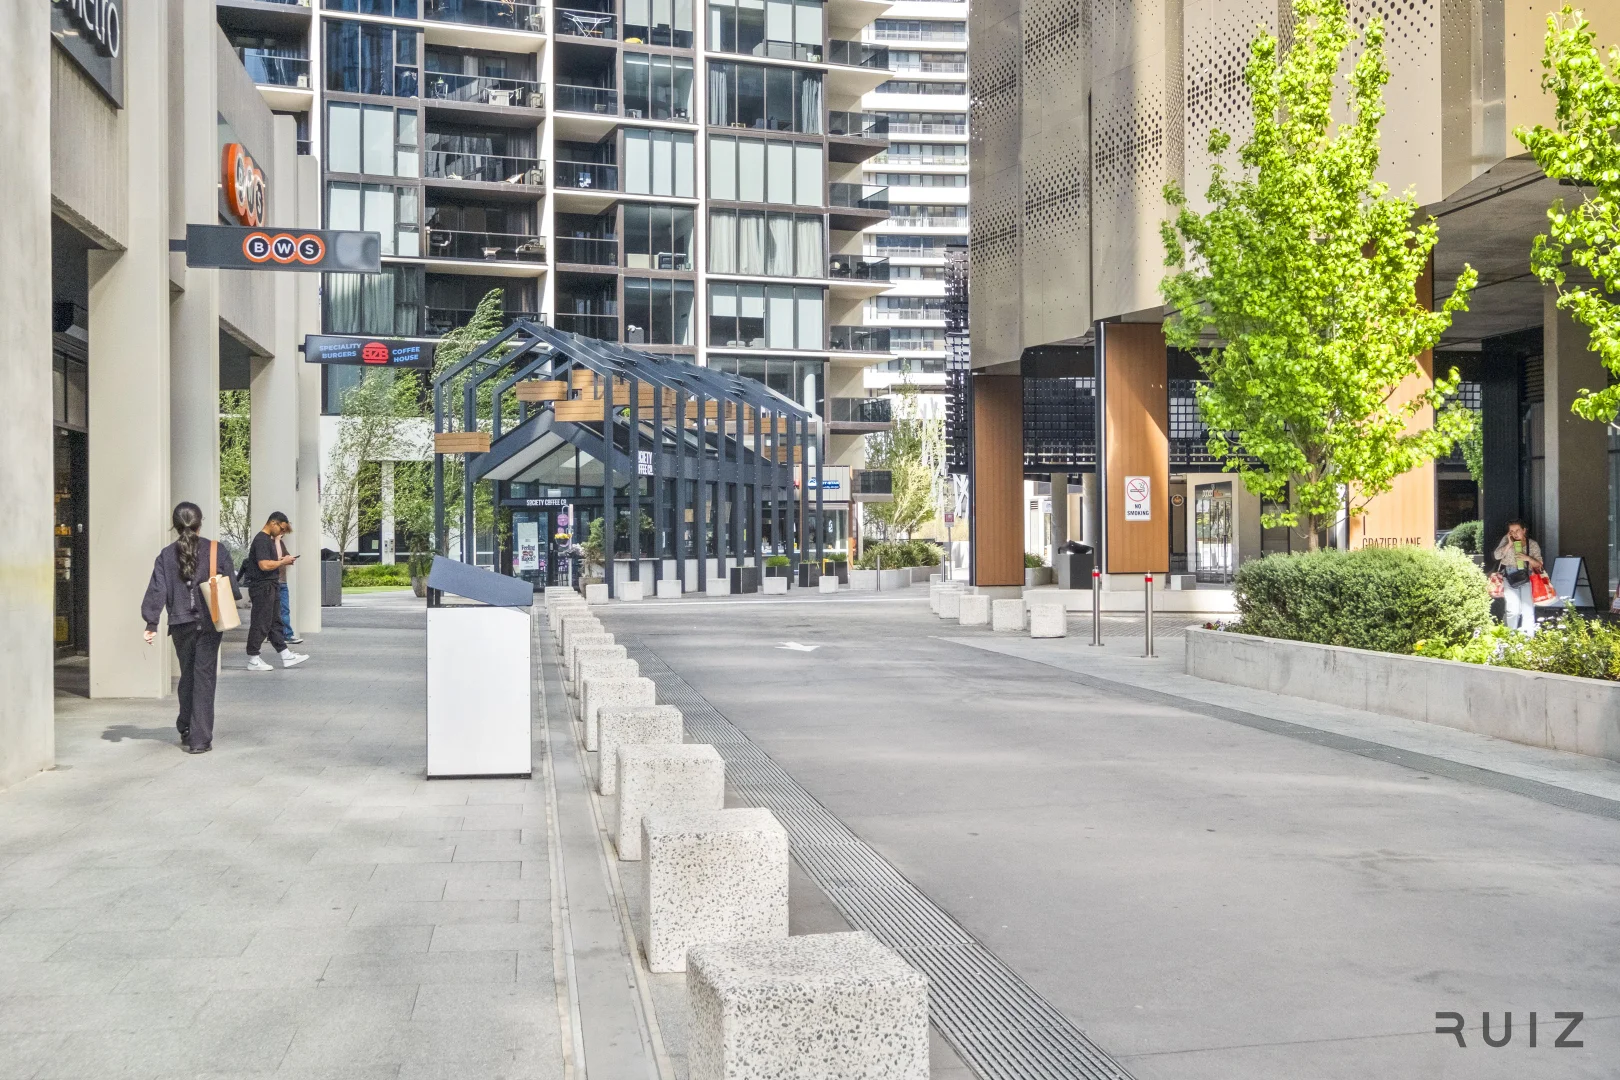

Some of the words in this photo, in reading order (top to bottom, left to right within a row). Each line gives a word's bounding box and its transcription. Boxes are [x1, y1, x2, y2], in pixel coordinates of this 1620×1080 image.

[319, 342, 361, 351] SPECIALITY
[392, 346, 421, 355] COFFEE
[321, 350, 357, 359] BURGERS
[393, 354, 419, 363] HOUSE
